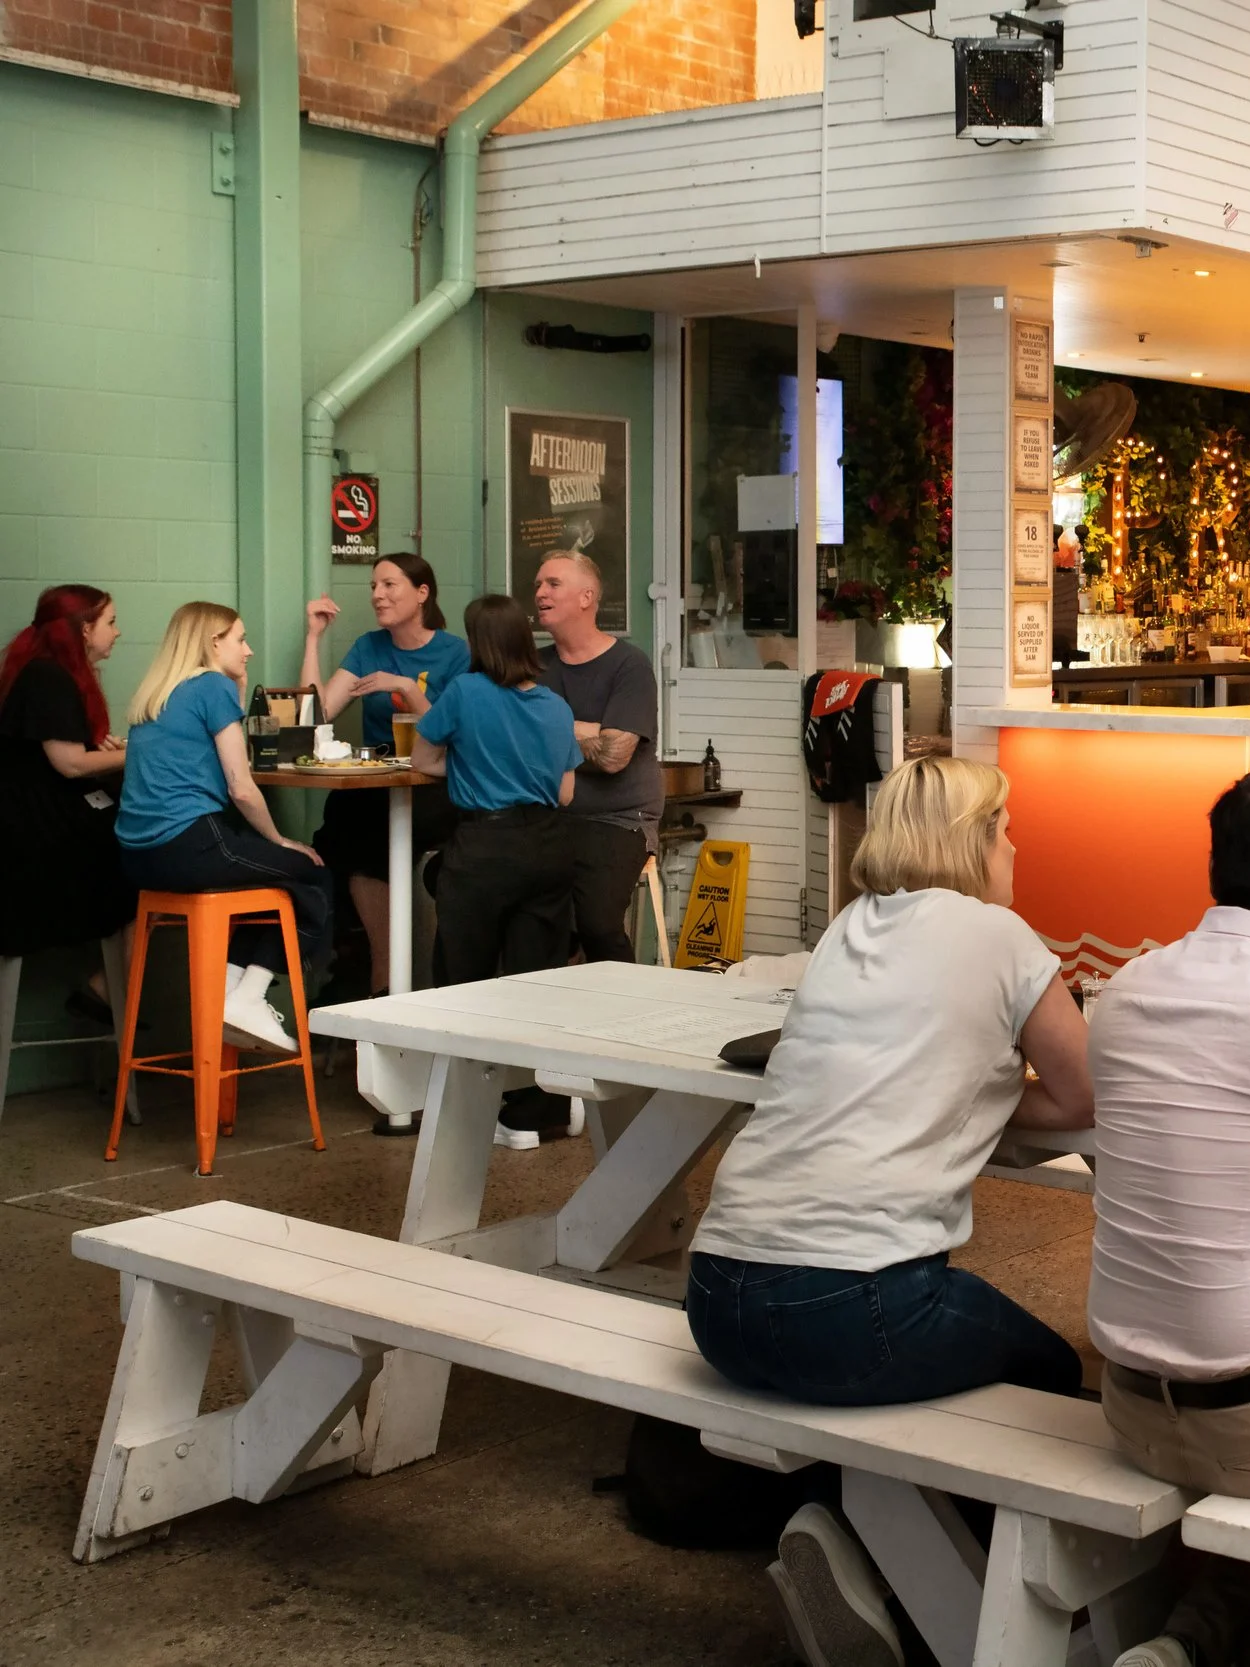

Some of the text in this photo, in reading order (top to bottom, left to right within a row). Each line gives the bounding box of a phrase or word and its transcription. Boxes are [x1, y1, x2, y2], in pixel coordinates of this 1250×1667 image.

[1024, 364, 1039, 372] AFTER
[1023, 437, 1040, 445] REFUSE
[1020, 444, 1042, 453] TO LEAVE
[530, 433, 606, 475] AFTERNOON
[1024, 453, 1039, 461] WHEN
[549, 476, 601, 506] SESSIONS
[1025, 525, 1037, 541] 18
[346, 534, 361, 544] NO
[331, 545, 376, 555] SMOKING
[1017, 630, 1036, 638] SERVED
[1019, 638, 1042, 646] SUPPLIED
[698, 884, 730, 896] CAUTION
[710, 894, 729, 902] FLOOR
[686, 943, 714, 953] CLEANING
[687, 950, 717, 959] PROGRE
